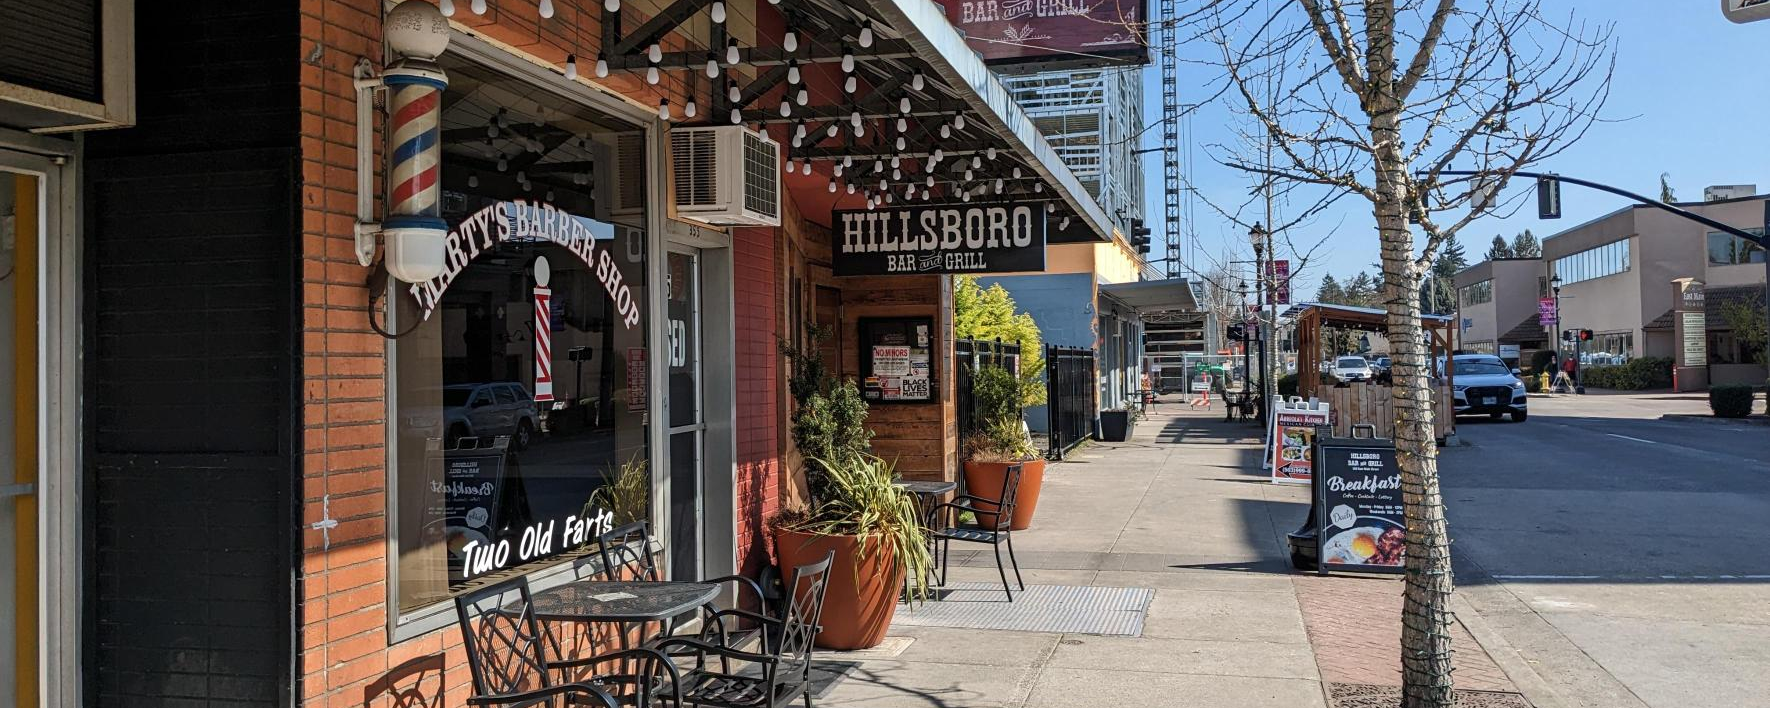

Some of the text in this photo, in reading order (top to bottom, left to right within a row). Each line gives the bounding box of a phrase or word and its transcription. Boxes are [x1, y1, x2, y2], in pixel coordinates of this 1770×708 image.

[962, 1, 1000, 24] BAR
[1001, 0, 1034, 21] and
[842, 205, 1032, 253] HILLSBORO
[513, 199, 596, 268] BARBER
[596, 249, 640, 330] SHOP
[887, 251, 987, 272] BAR and GRILL
[875, 348, 908, 357] NO MINORS
[903, 384, 928, 392] LIVES
[1326, 473, 1402, 493] Breakfast
[1332, 509, 1354, 523] Daily
[462, 507, 614, 578] Two Old Farts
